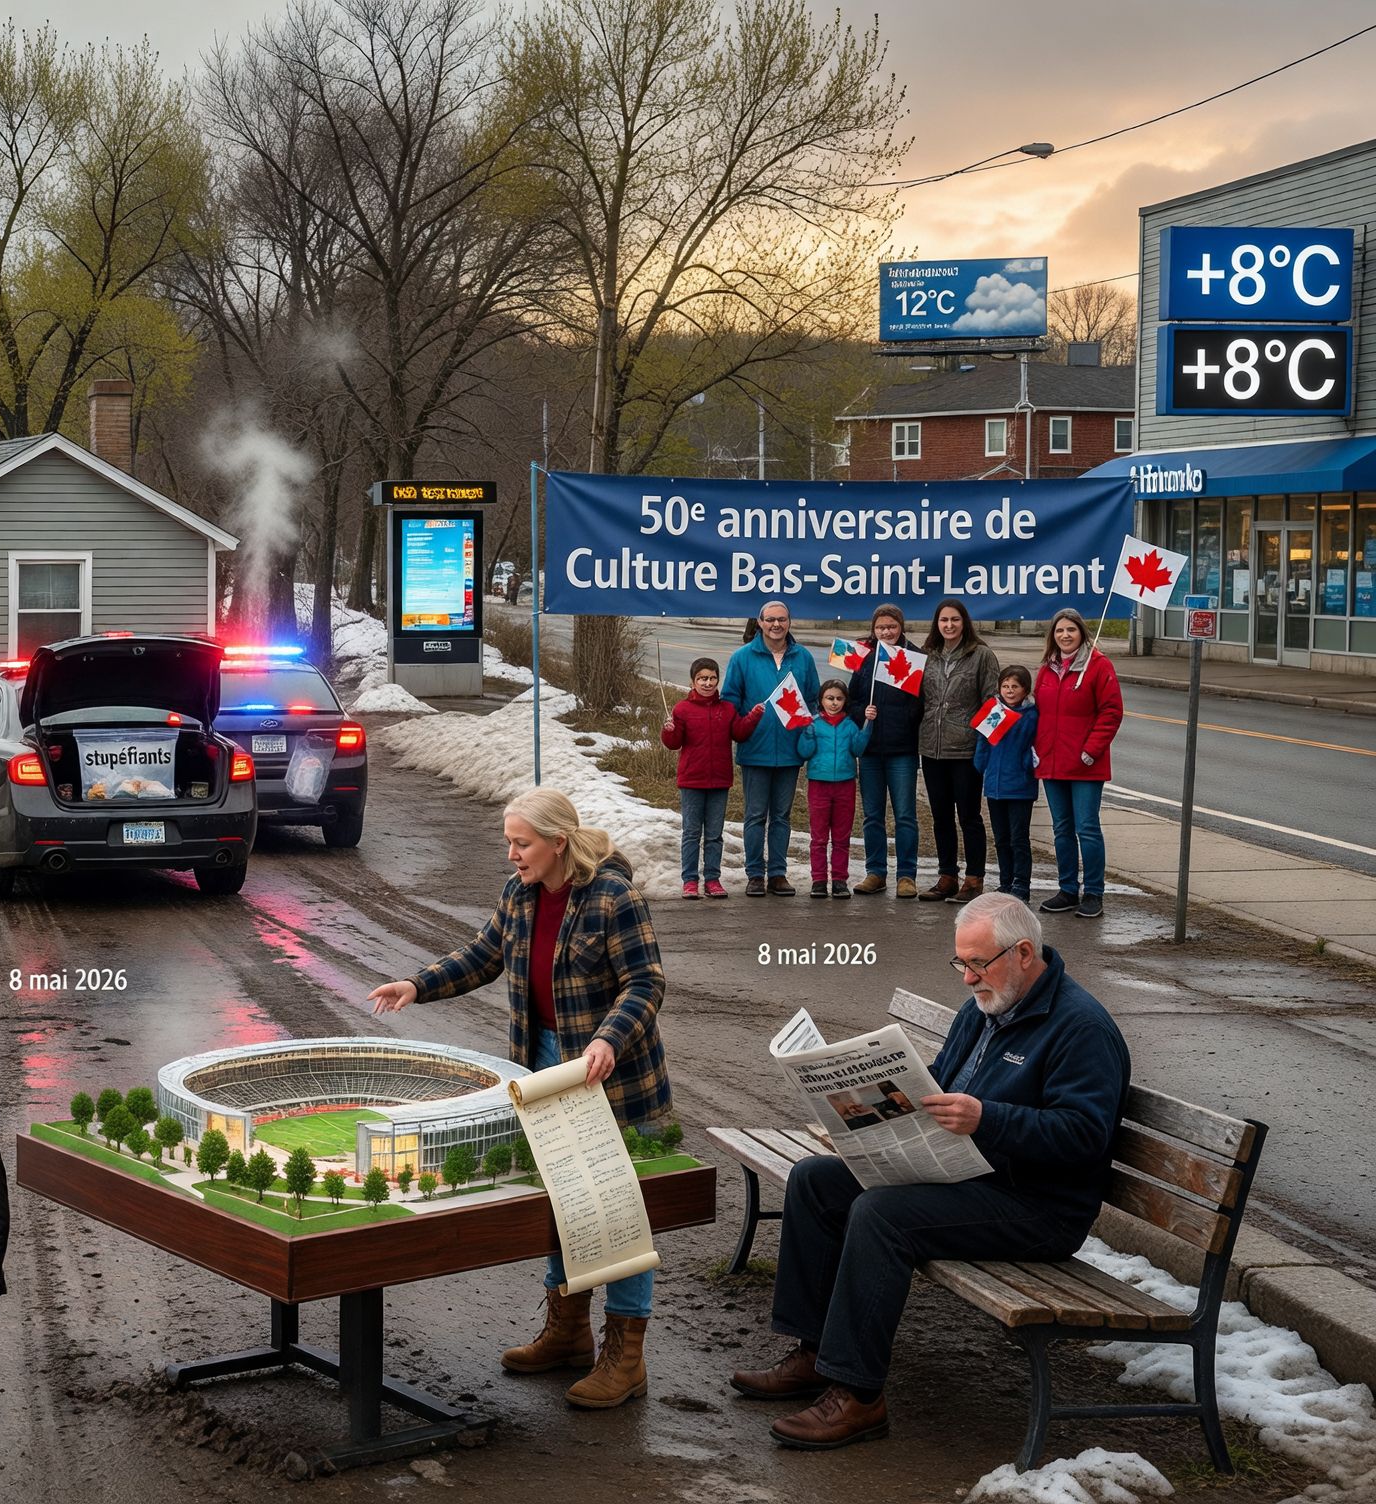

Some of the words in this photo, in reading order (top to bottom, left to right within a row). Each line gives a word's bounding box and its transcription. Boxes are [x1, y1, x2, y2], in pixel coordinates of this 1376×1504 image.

[1186, 244, 1341, 307] +8°C
[895, 289, 956, 317] 12°C
[1182, 338, 1337, 401] +8°C
[717, 497, 974, 541] anniversaire
[985, 497, 1037, 540] de
[565, 547, 718, 592] Culture
[730, 552, 1106, 596] Bas-Saint-Laurent
[85, 746, 172, 770] stupéfiants
